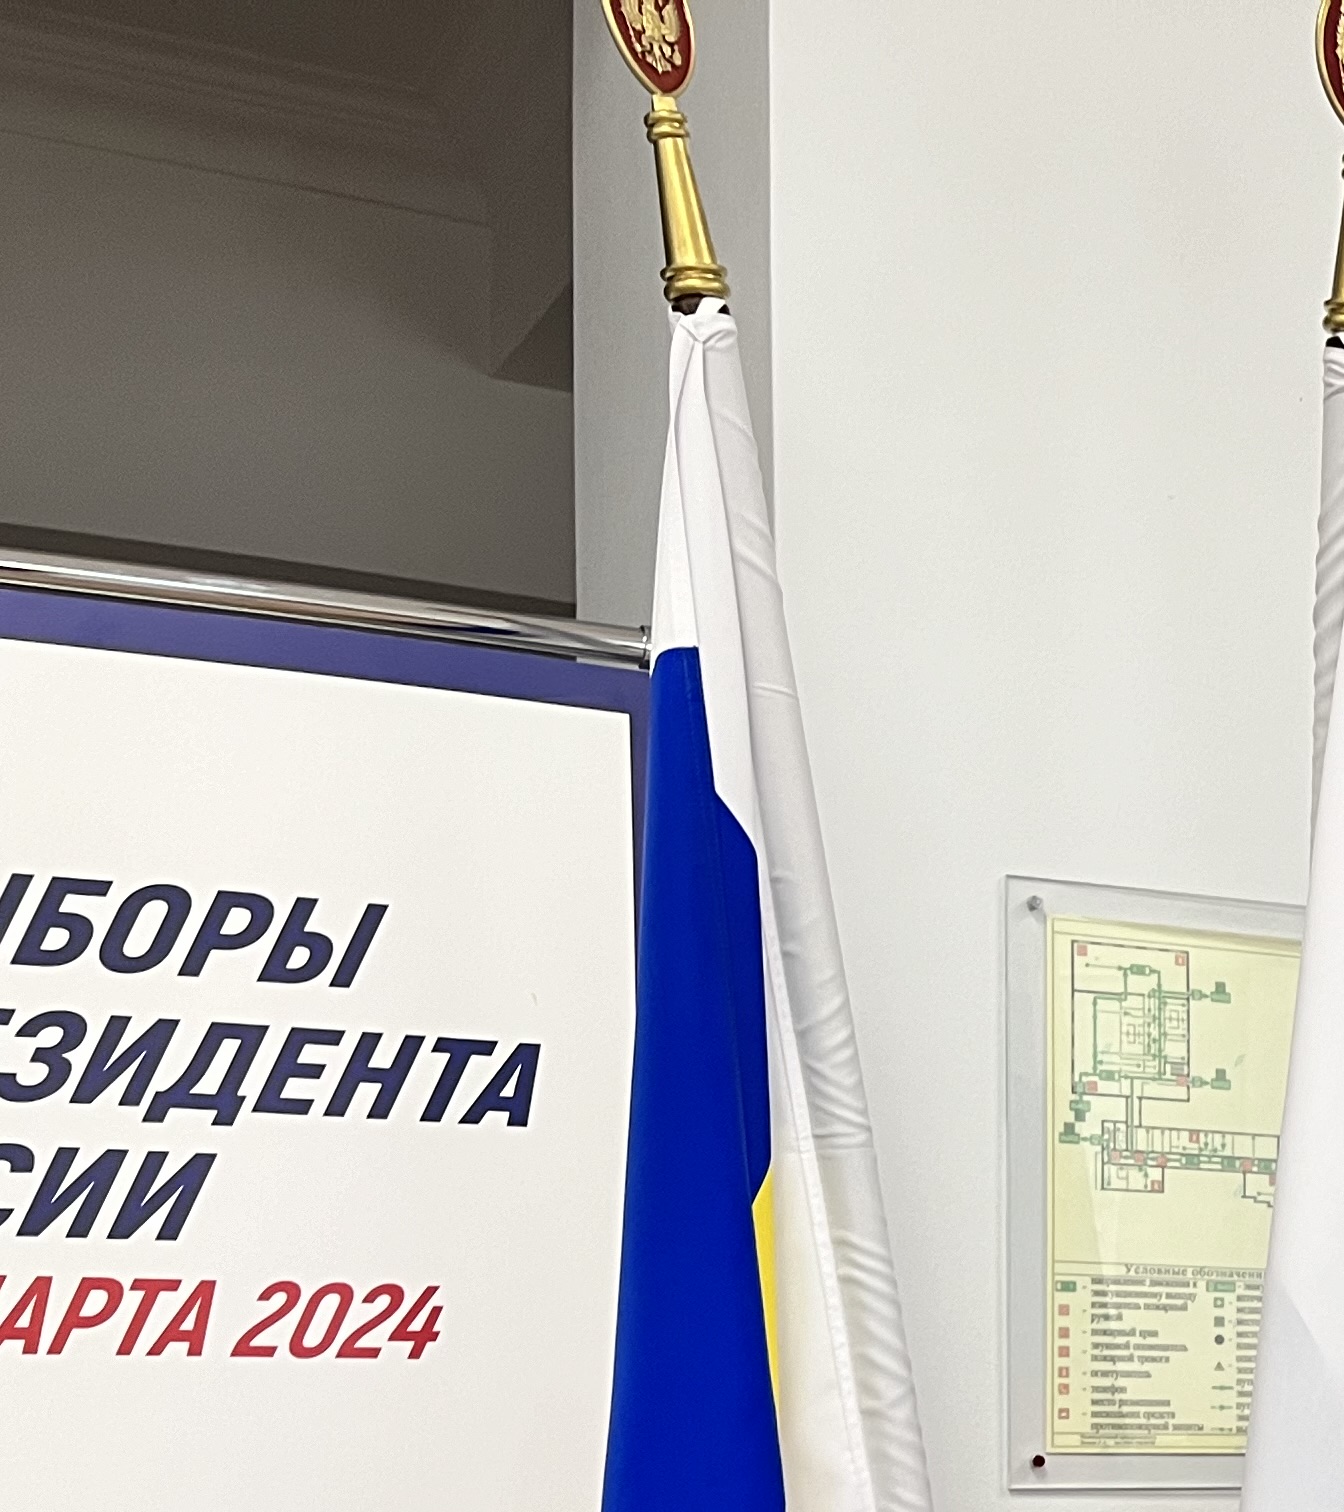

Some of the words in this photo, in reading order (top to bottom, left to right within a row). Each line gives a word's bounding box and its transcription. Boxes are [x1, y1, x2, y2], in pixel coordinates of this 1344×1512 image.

[0, 1006, 542, 1128] ЗИДЕНТА
[0, 1274, 217, 1357] АРТА
[229, 1280, 444, 1360] 2024
